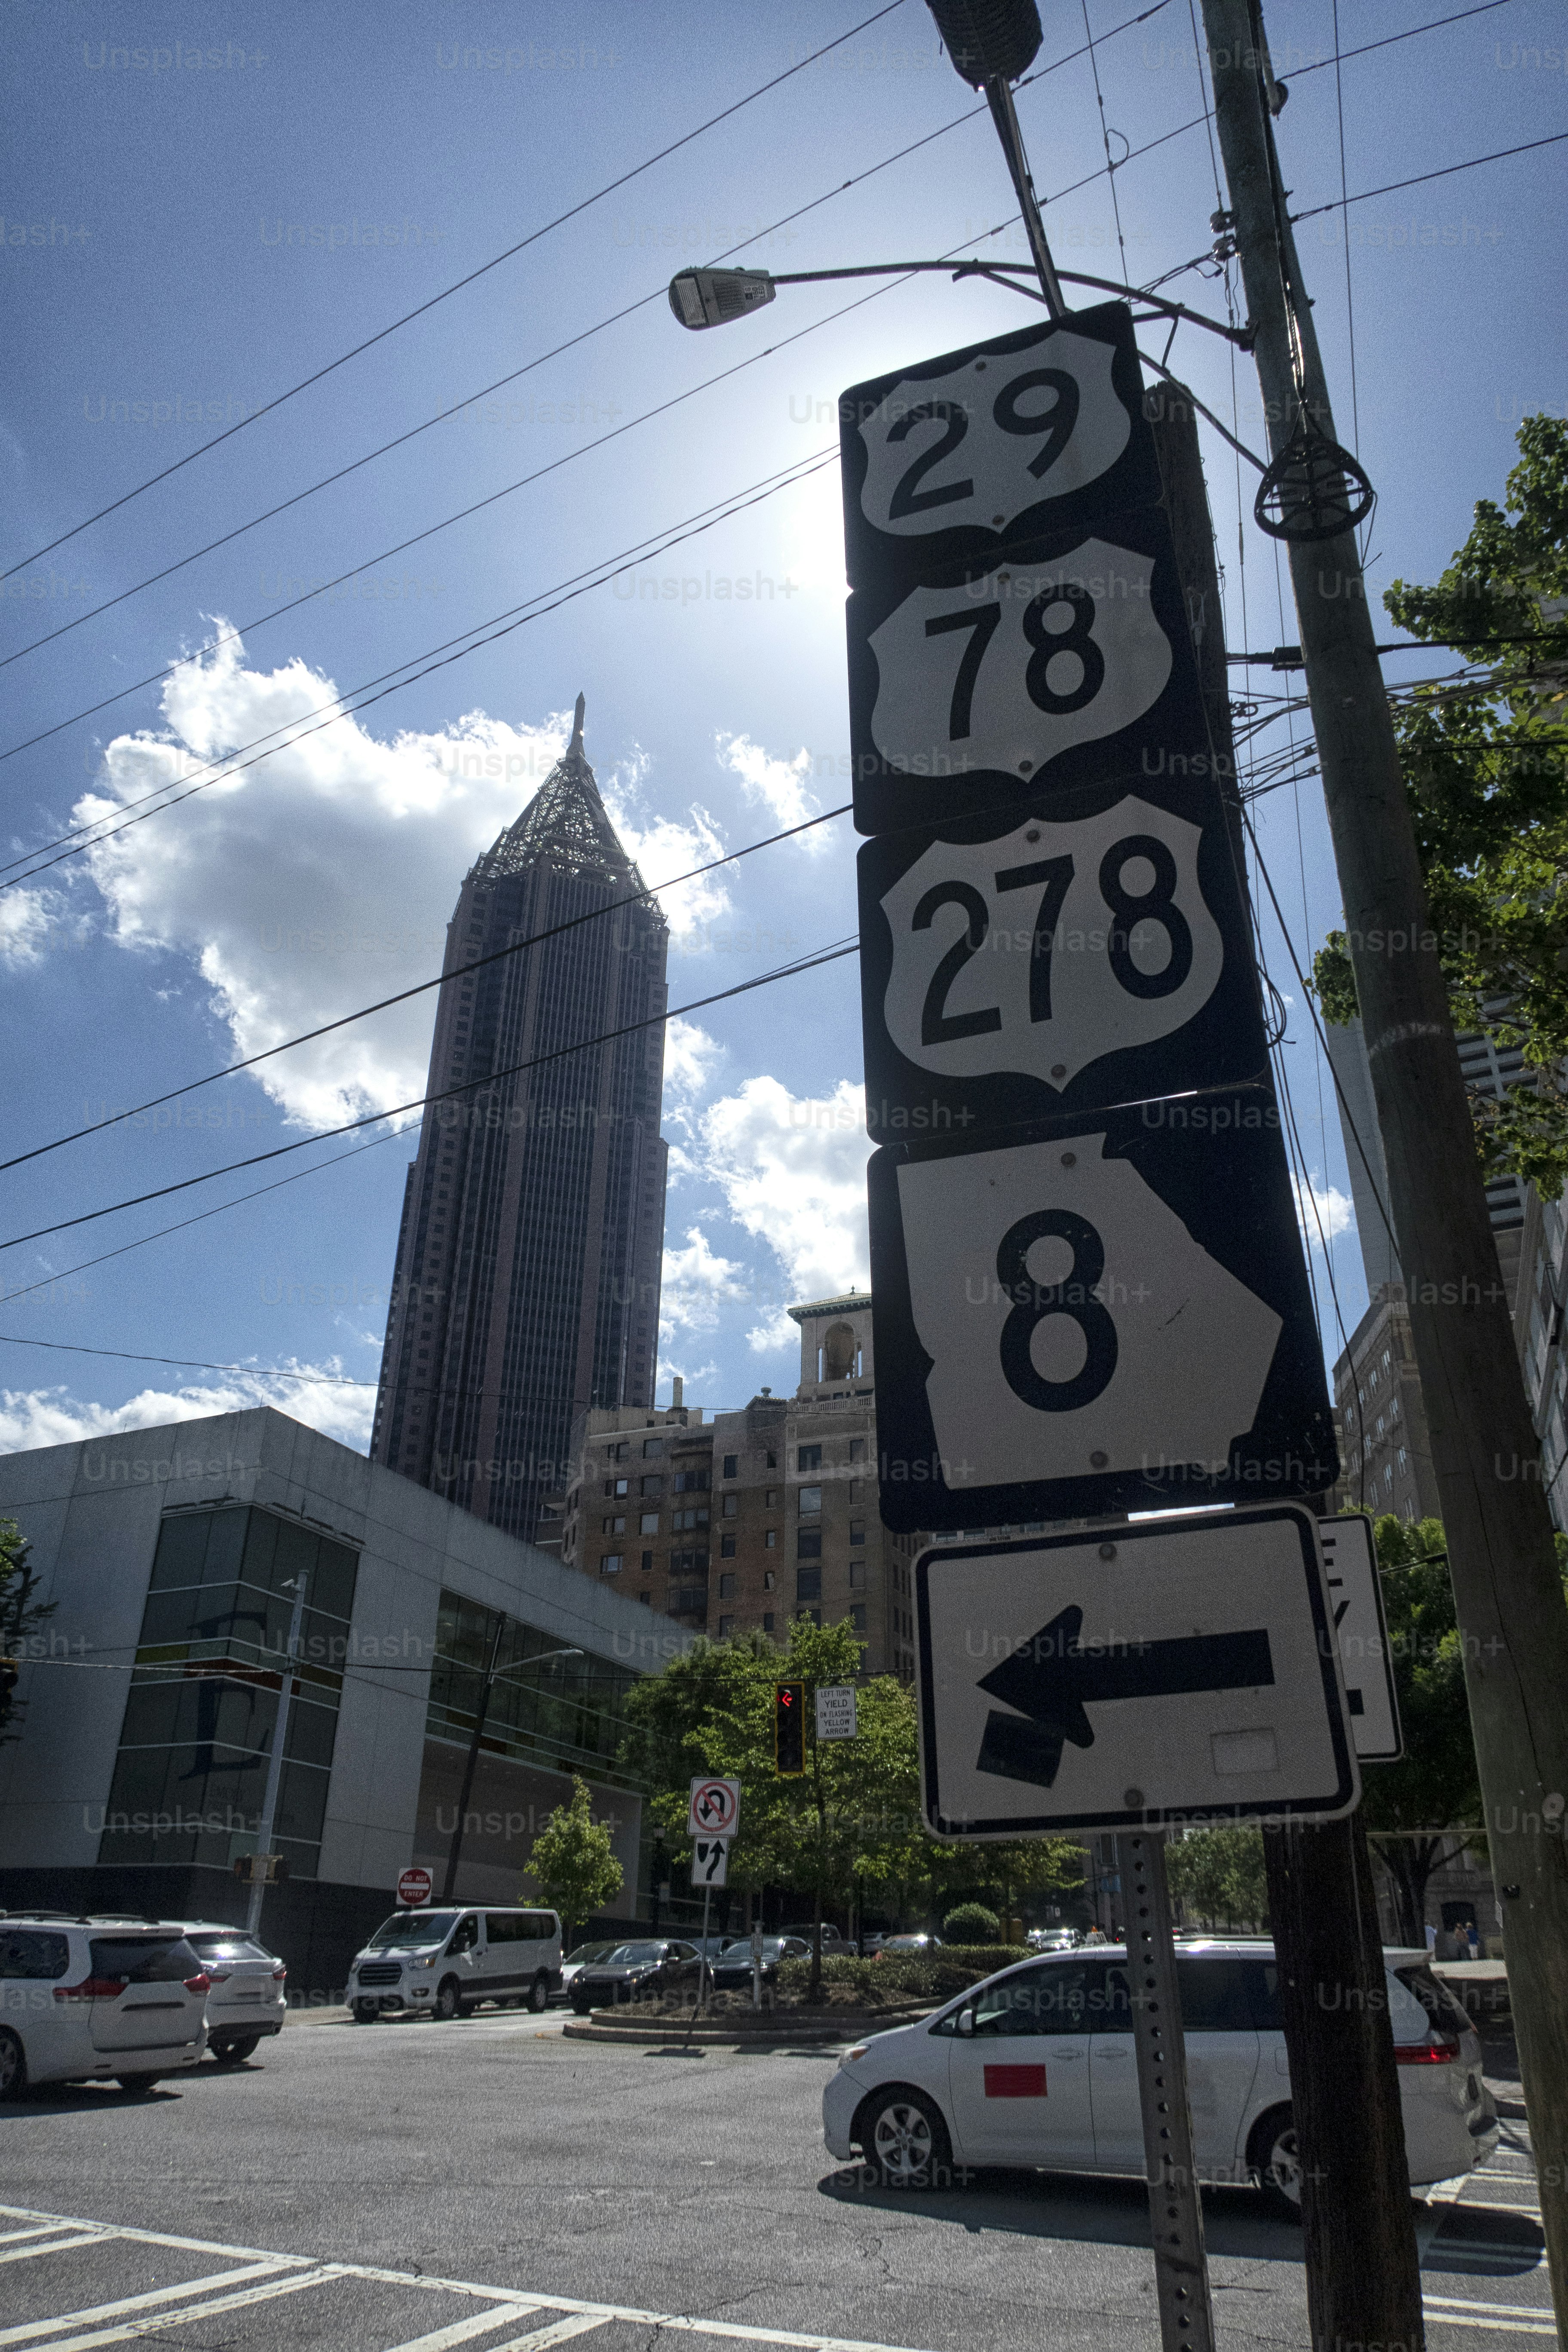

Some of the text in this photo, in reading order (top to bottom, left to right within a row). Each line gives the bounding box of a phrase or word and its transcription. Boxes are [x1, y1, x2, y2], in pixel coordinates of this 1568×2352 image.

[885, 368, 1080, 521] 29
[924, 585, 1105, 741] 78
[911, 834, 1194, 1047] 278
[996, 1208, 1119, 1412] 8
[824, 1699, 848, 1708] YIELD
[829, 1709, 853, 1718] FLASHING
